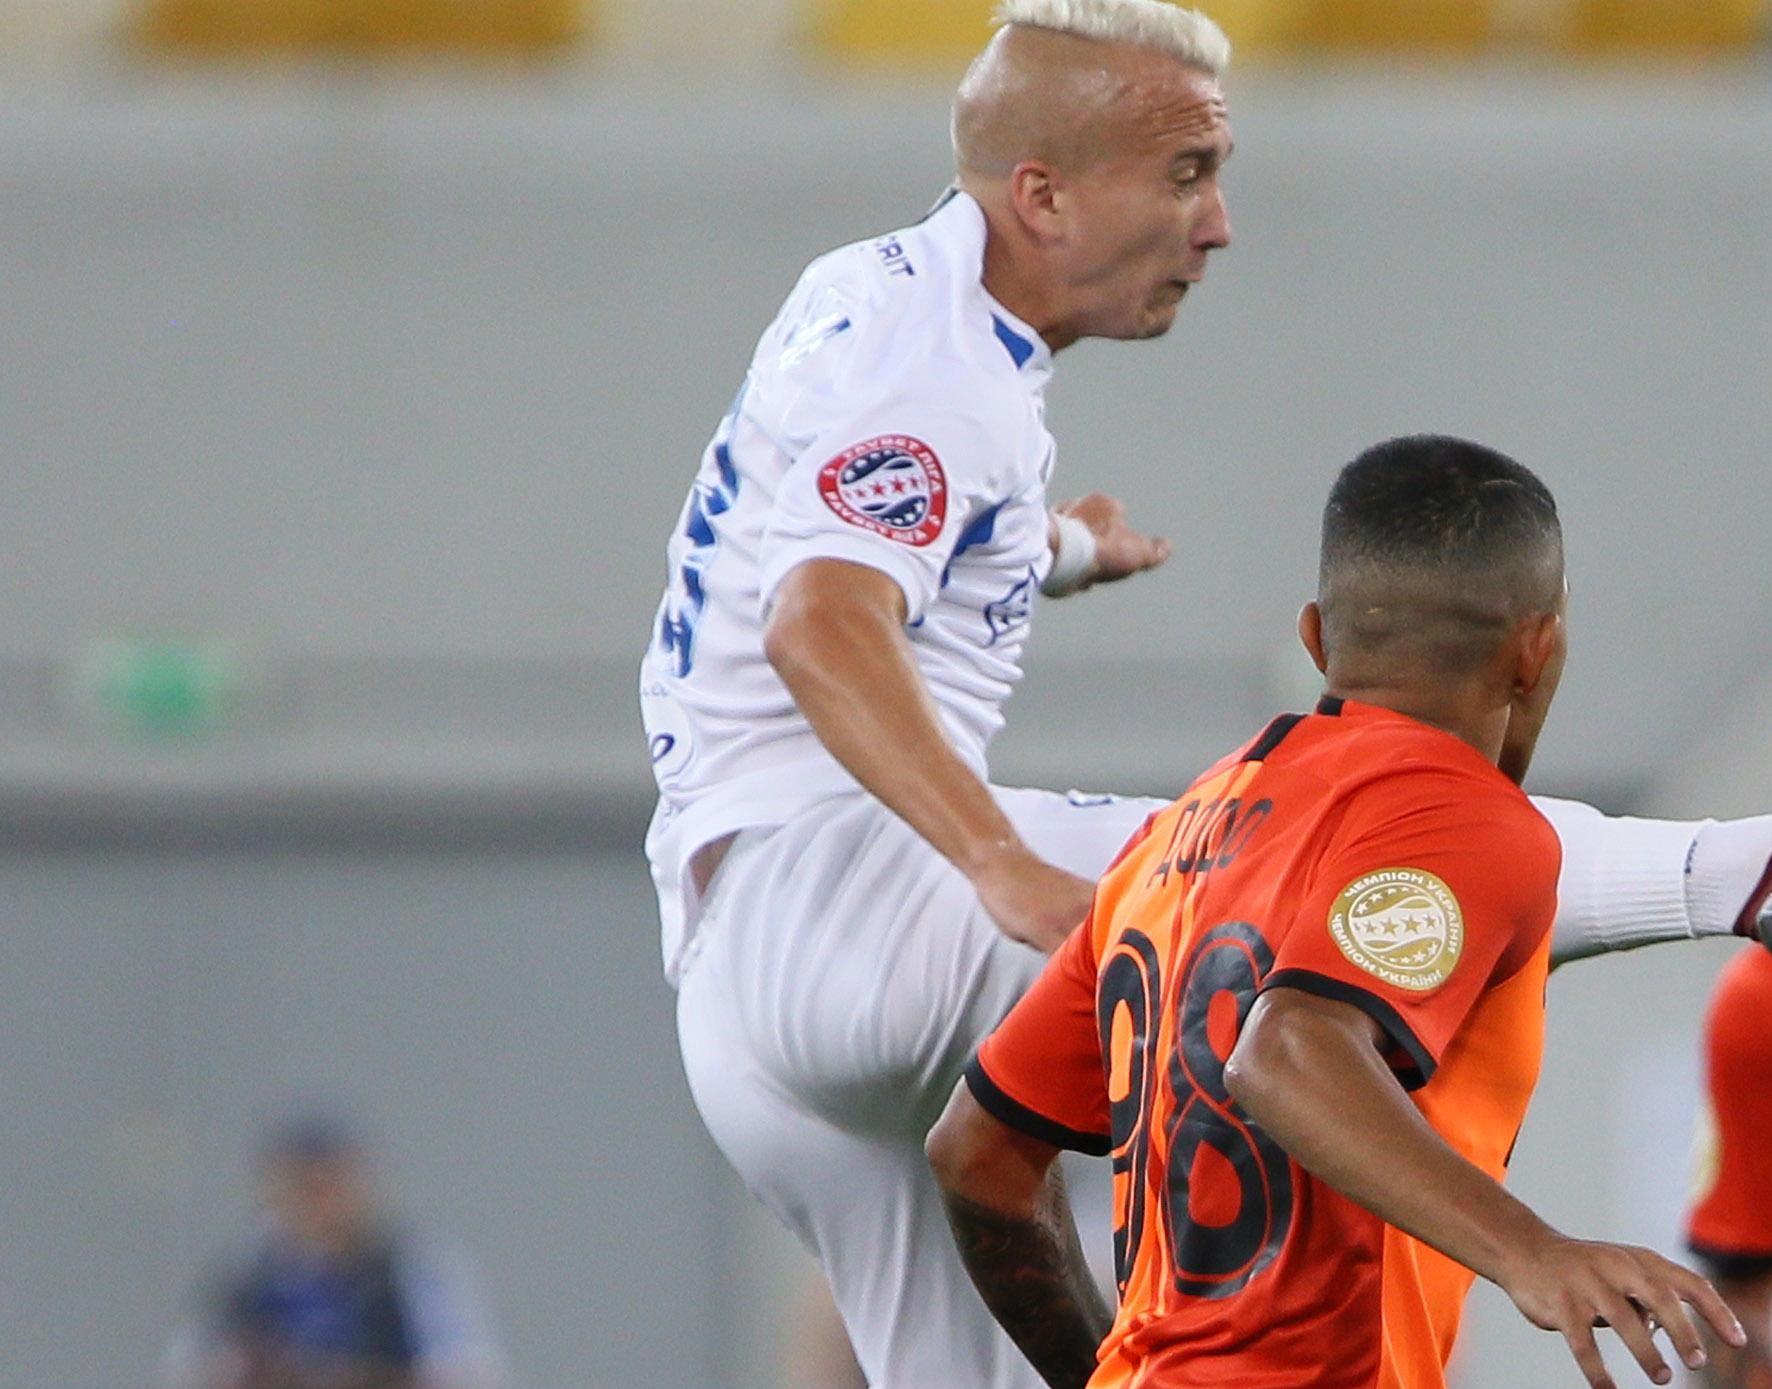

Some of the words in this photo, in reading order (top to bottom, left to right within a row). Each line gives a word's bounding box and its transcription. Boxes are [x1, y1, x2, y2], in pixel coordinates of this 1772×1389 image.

[1331, 913, 1377, 972] ЧЕМПІОН
[1379, 968, 1443, 987] УКРАЇНИ
[1343, 871, 1424, 898] ЧЕМПІОН
[1426, 880, 1460, 954] УКРАЇНИ
[1096, 921, 1301, 1303] 98
